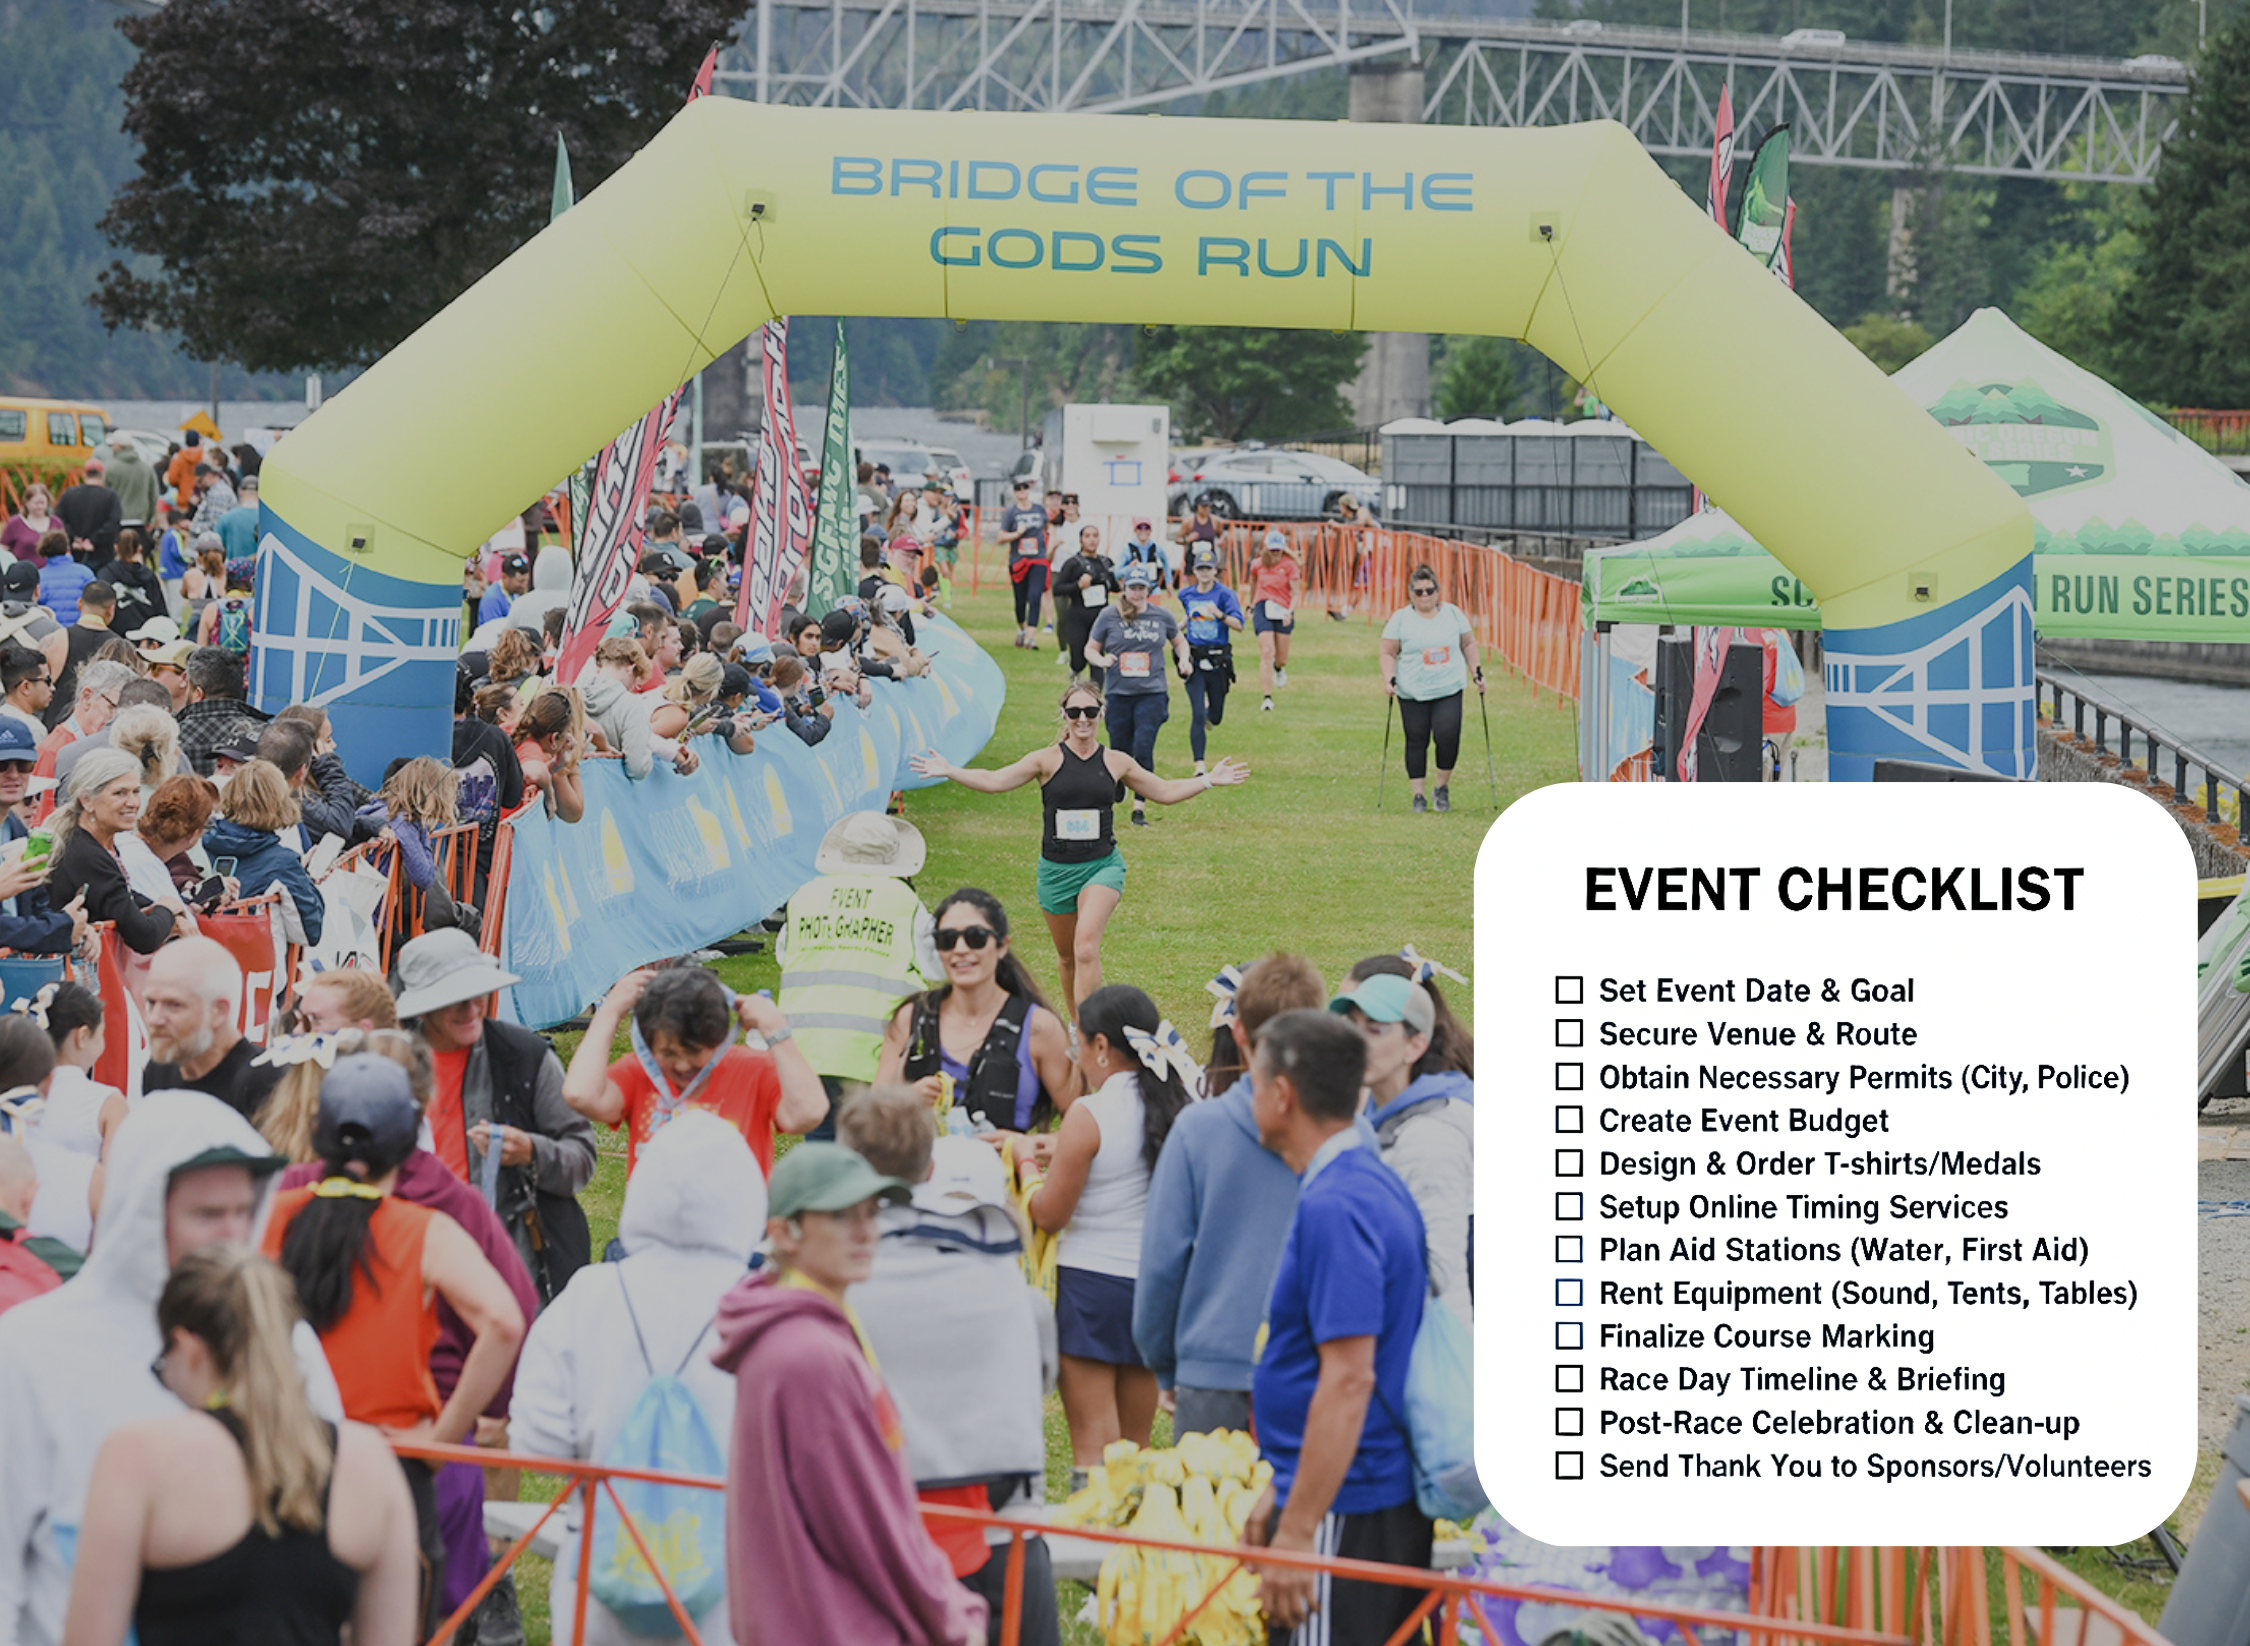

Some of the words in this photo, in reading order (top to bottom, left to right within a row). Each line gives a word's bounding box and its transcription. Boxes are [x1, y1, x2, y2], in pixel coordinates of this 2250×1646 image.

[832, 156, 1138, 206] BRIDGE
[1174, 170, 1288, 211] OF
[1306, 172, 1474, 211] THE
[930, 227, 1163, 274] GODS
[1198, 236, 1372, 277] RUN
[1989, 443, 2074, 461] SERIES
[1999, 425, 2099, 447] OREGON
[2052, 574, 2119, 614] RUN
[2133, 576, 2249, 618] SERIES
